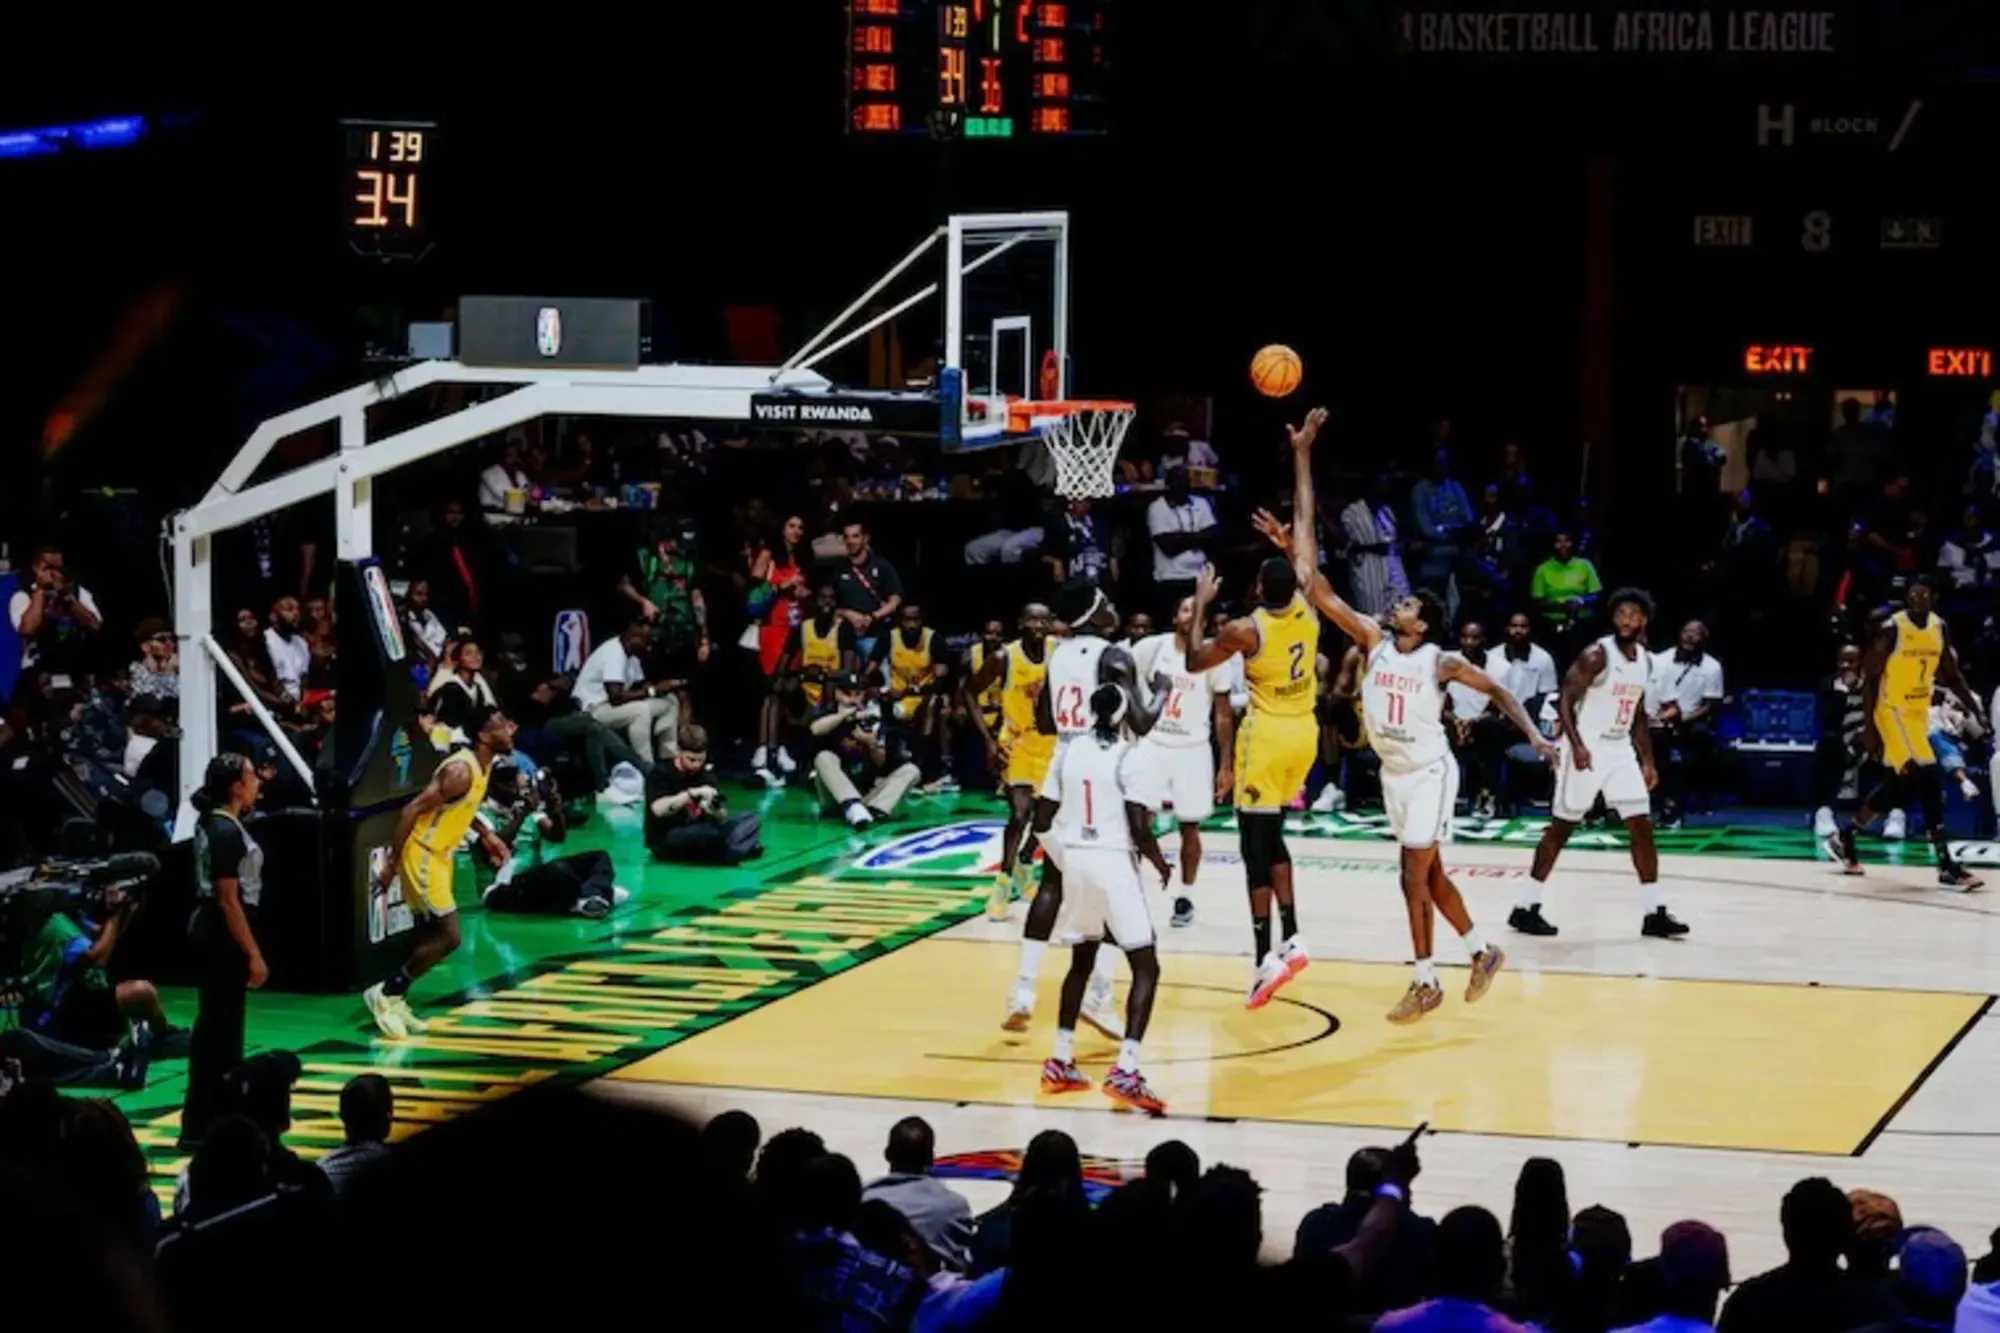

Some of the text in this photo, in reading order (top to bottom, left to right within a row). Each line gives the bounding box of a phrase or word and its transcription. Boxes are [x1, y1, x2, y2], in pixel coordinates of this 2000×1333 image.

[1419, 11, 1836, 53] BASKETBALL AFRICA LEAGUE
[1756, 103, 1880, 147] H BLOCK
[355, 171, 415, 227] 34
[1700, 217, 1748, 246] EXIT
[1801, 209, 1832, 255] 8
[1744, 346, 1812, 372] EXIT
[755, 404, 873, 421] VISIT RWANDA
[1288, 641, 1305, 680] 2
[1056, 685, 1087, 728] 42
[1386, 692, 1405, 726] 11
[1082, 779, 1093, 826] 1
